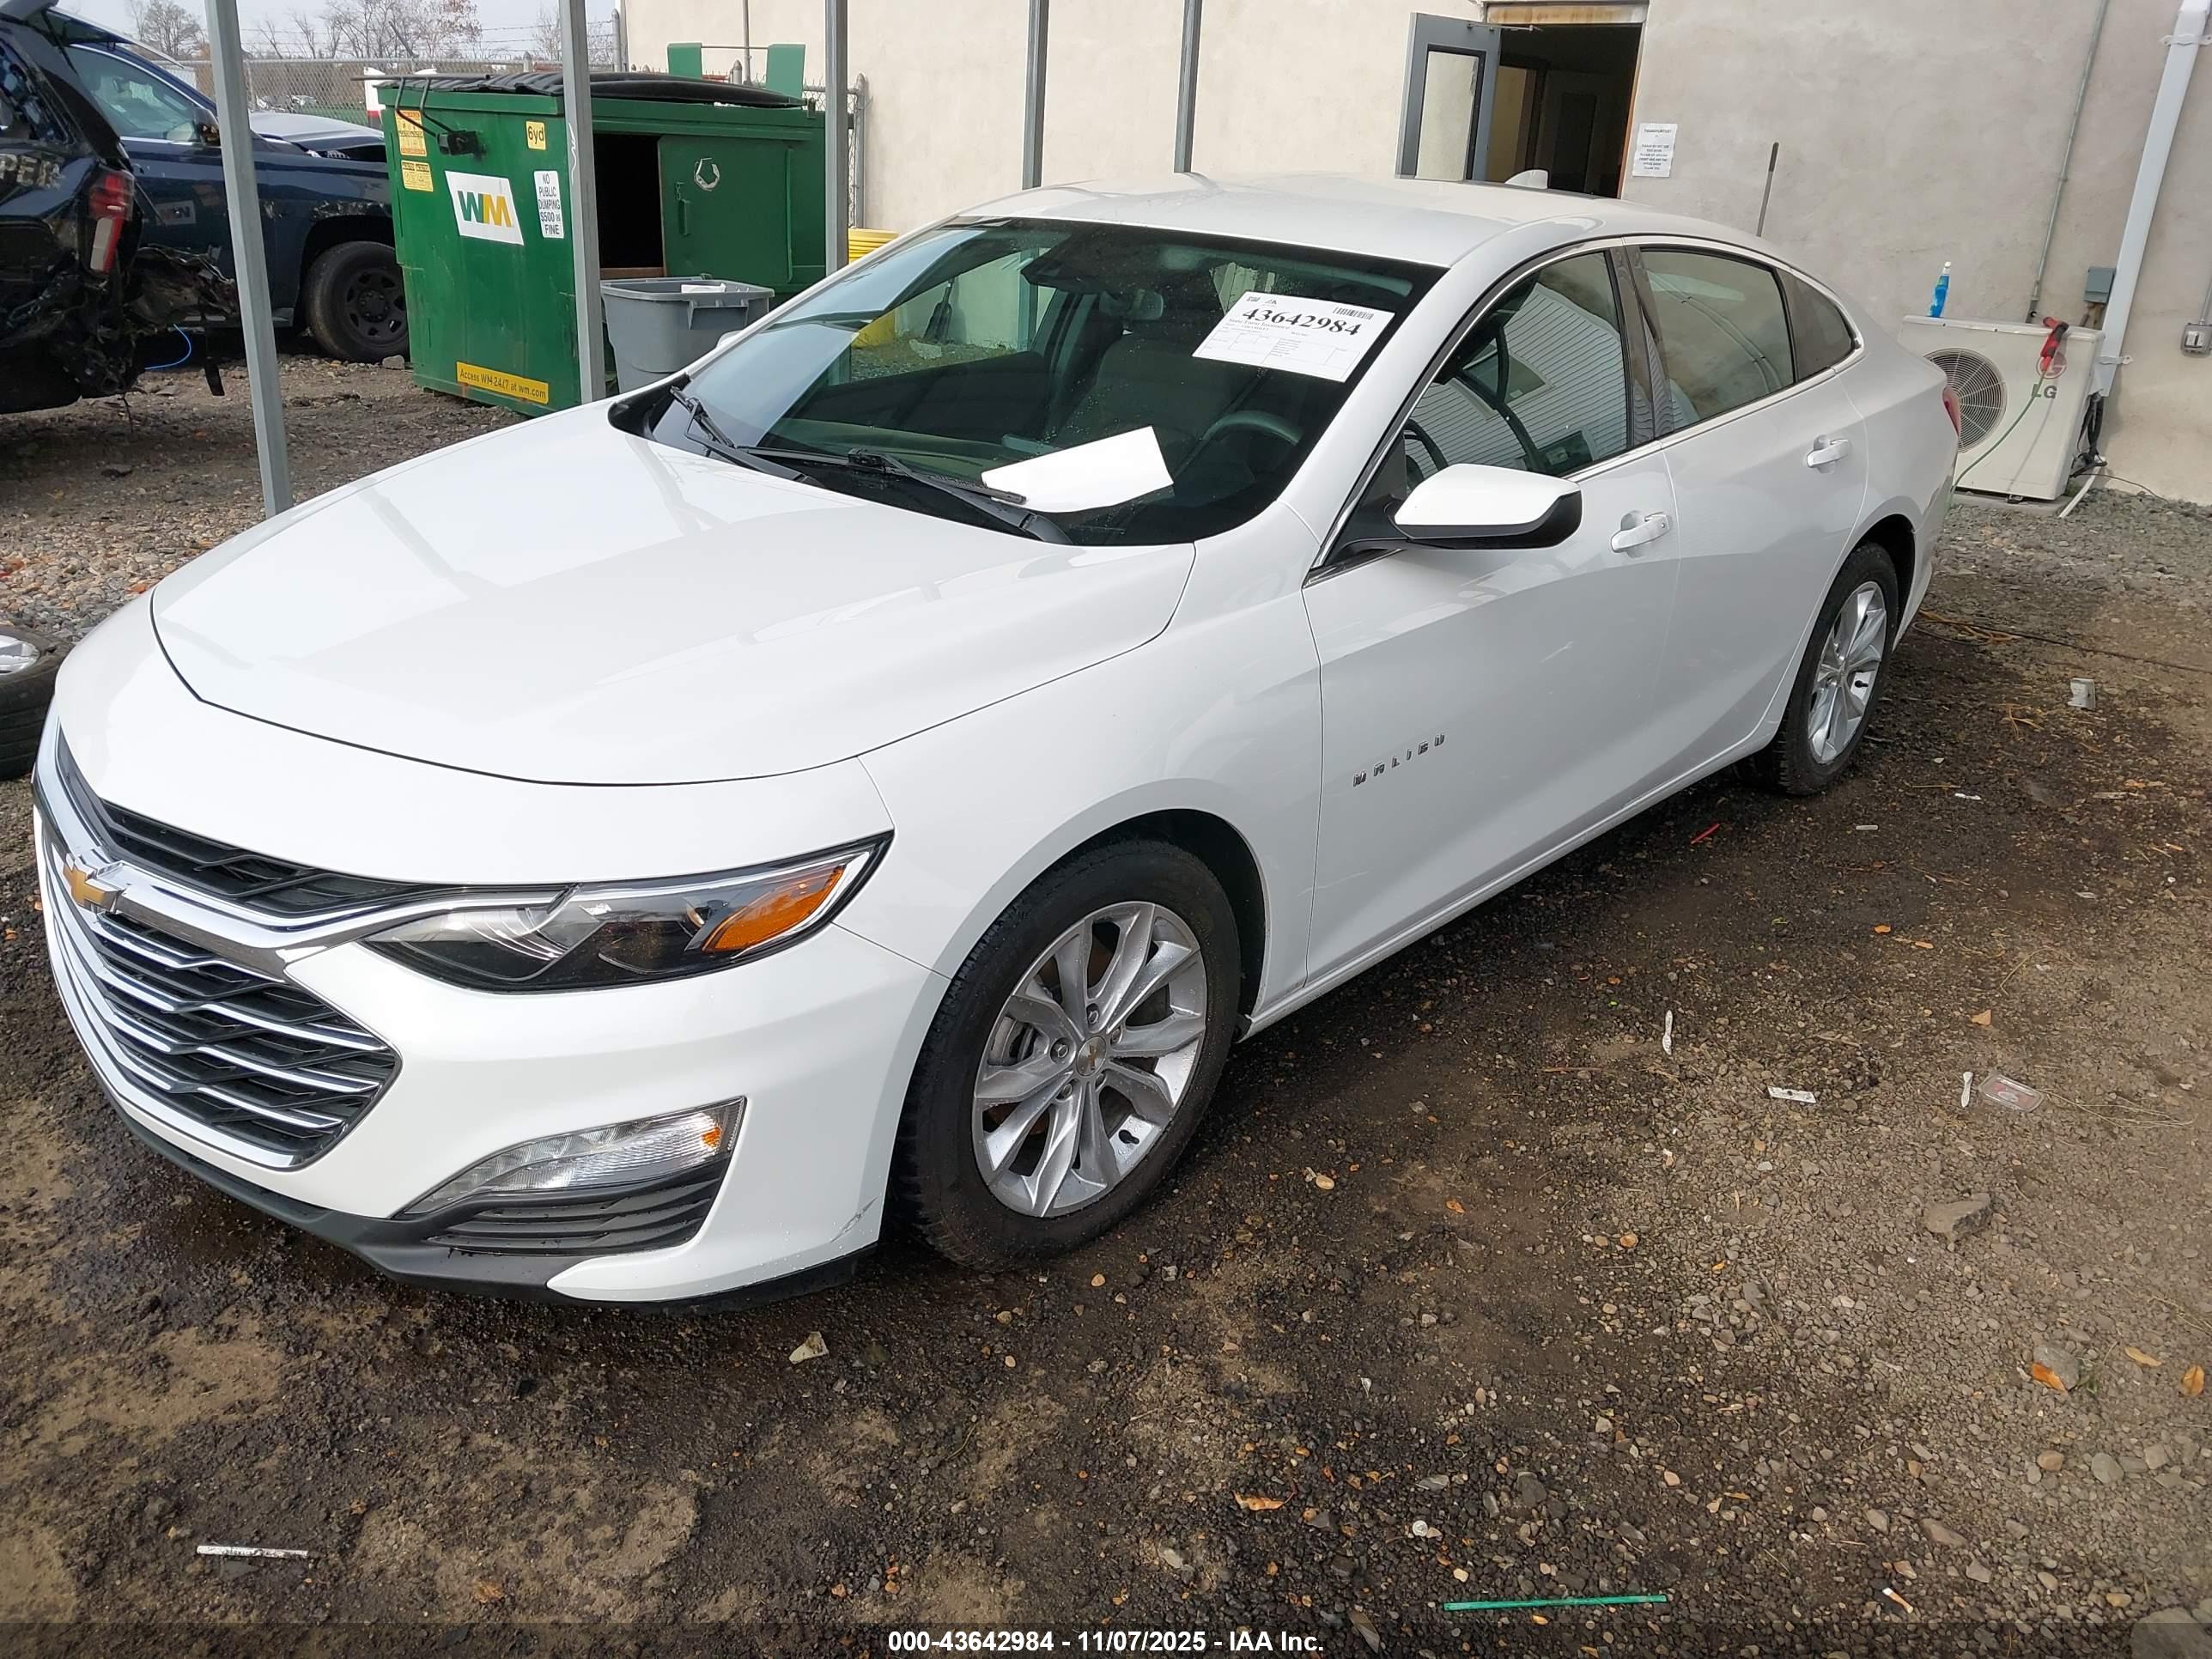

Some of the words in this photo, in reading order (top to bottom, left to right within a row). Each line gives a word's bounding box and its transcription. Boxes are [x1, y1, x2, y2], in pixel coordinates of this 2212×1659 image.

[527, 126, 544, 144] 6yd
[542, 173, 550, 185] NO
[538, 186, 556, 198] PUBLIC
[457, 190, 514, 228] WM
[538, 198, 561, 210] DUMPING
[540, 212, 555, 222] $500
[544, 224, 560, 235] FINE
[1243, 307, 1363, 336] 43642984
[459, 368, 480, 381] Access
[494, 376, 509, 390] 24/7
[518, 386, 546, 398] wm.com
[2031, 383, 2057, 399] LG
[1353, 733, 1445, 787] MALIBU
